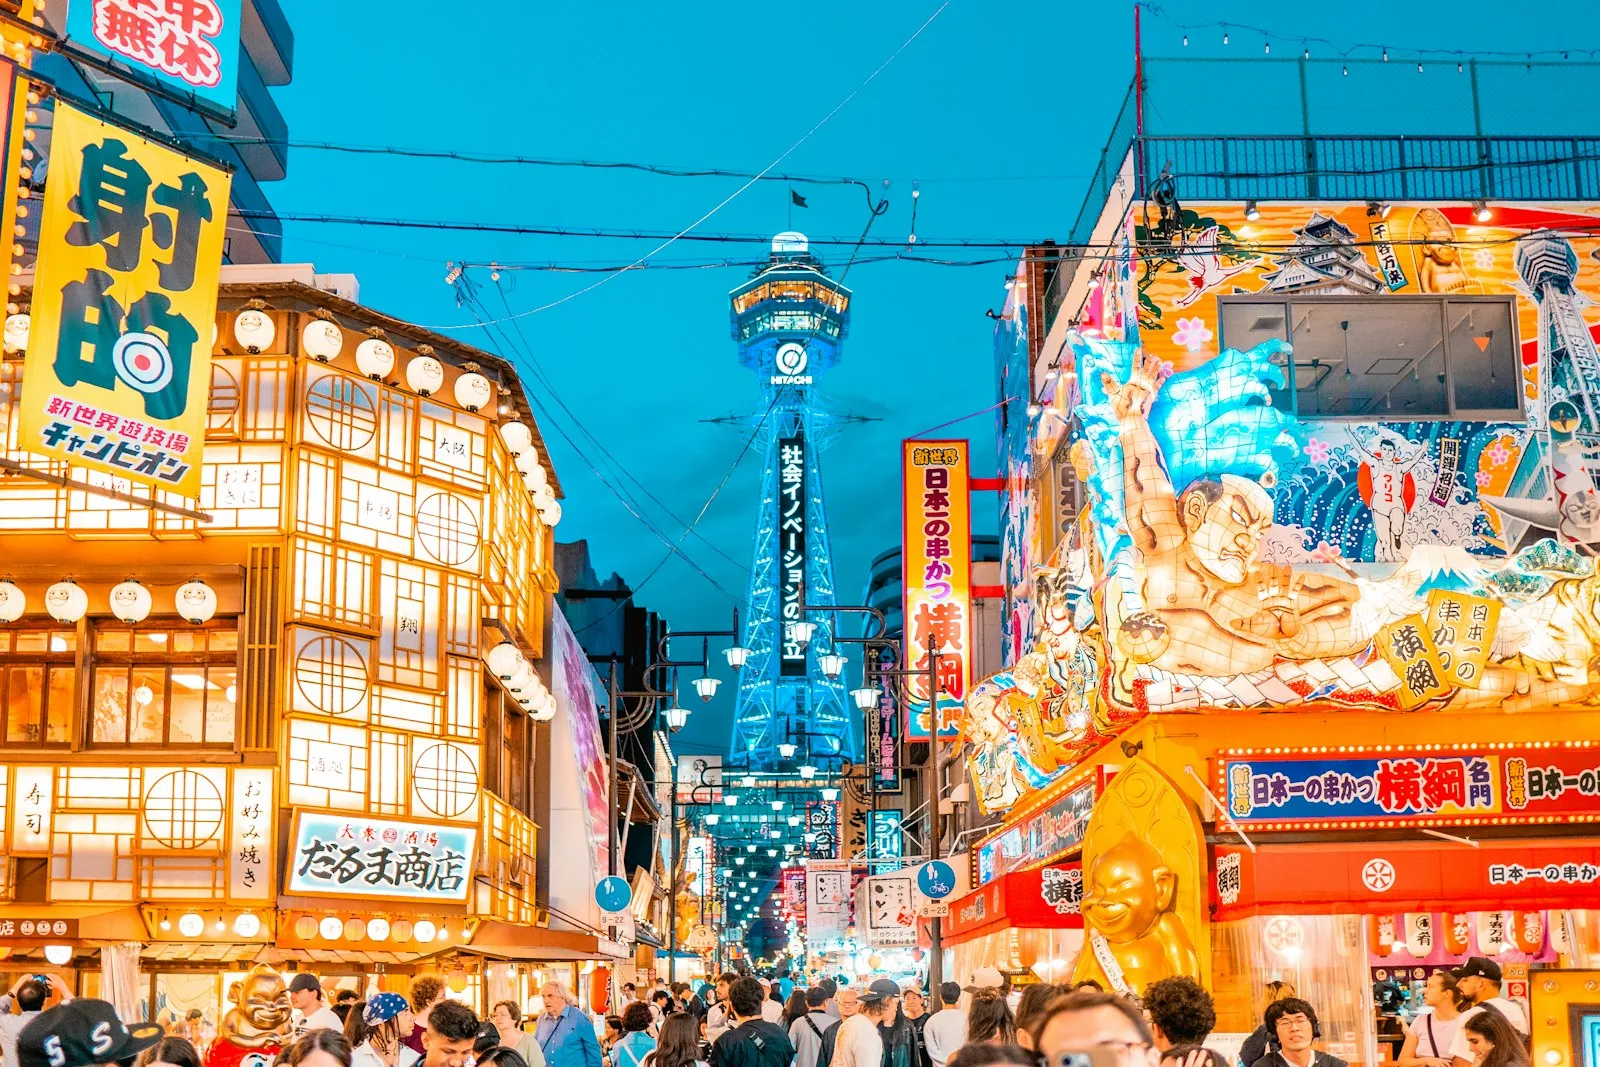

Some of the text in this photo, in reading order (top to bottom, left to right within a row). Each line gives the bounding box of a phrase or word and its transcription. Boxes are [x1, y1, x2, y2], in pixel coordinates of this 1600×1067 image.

[103, 3, 212, 78] 無休
[127, 0, 215, 33] 中
[52, 138, 213, 420] 射的
[1374, 224, 1403, 284] 千客万来
[770, 376, 813, 385] HITACHI
[47, 397, 189, 453] 新世界遊技場
[439, 437, 467, 458] 大阪
[43, 423, 189, 482] チャンピオン
[914, 448, 958, 465] 新世界
[1434, 440, 1456, 501] 開運招福
[924, 468, 951, 599] 日本一の串かつ
[914, 602, 963, 700] 横綱
[1391, 624, 1440, 698] 横綱
[1432, 600, 1461, 670] 串かつ
[1457, 605, 1488, 680] 日本一の
[24, 782, 44, 835] 寿司
[1232, 760, 1491, 814] 新世界 日本一の串かつ 横綱 名門
[1508, 760, 1600, 806] 新世界 日本一の
[239, 781, 263, 888] お好み焼き
[340, 824, 440, 847] 大衆 酒場
[298, 838, 466, 891] だるま商店
[1491, 866, 1597, 882] 日本一の串か
[0, 919, 15, 936] 店
[602, 916, 624, 924] 9-22
[1489, 913, 1503, 944] 千客万来
[90, 1021, 113, 1055] S
